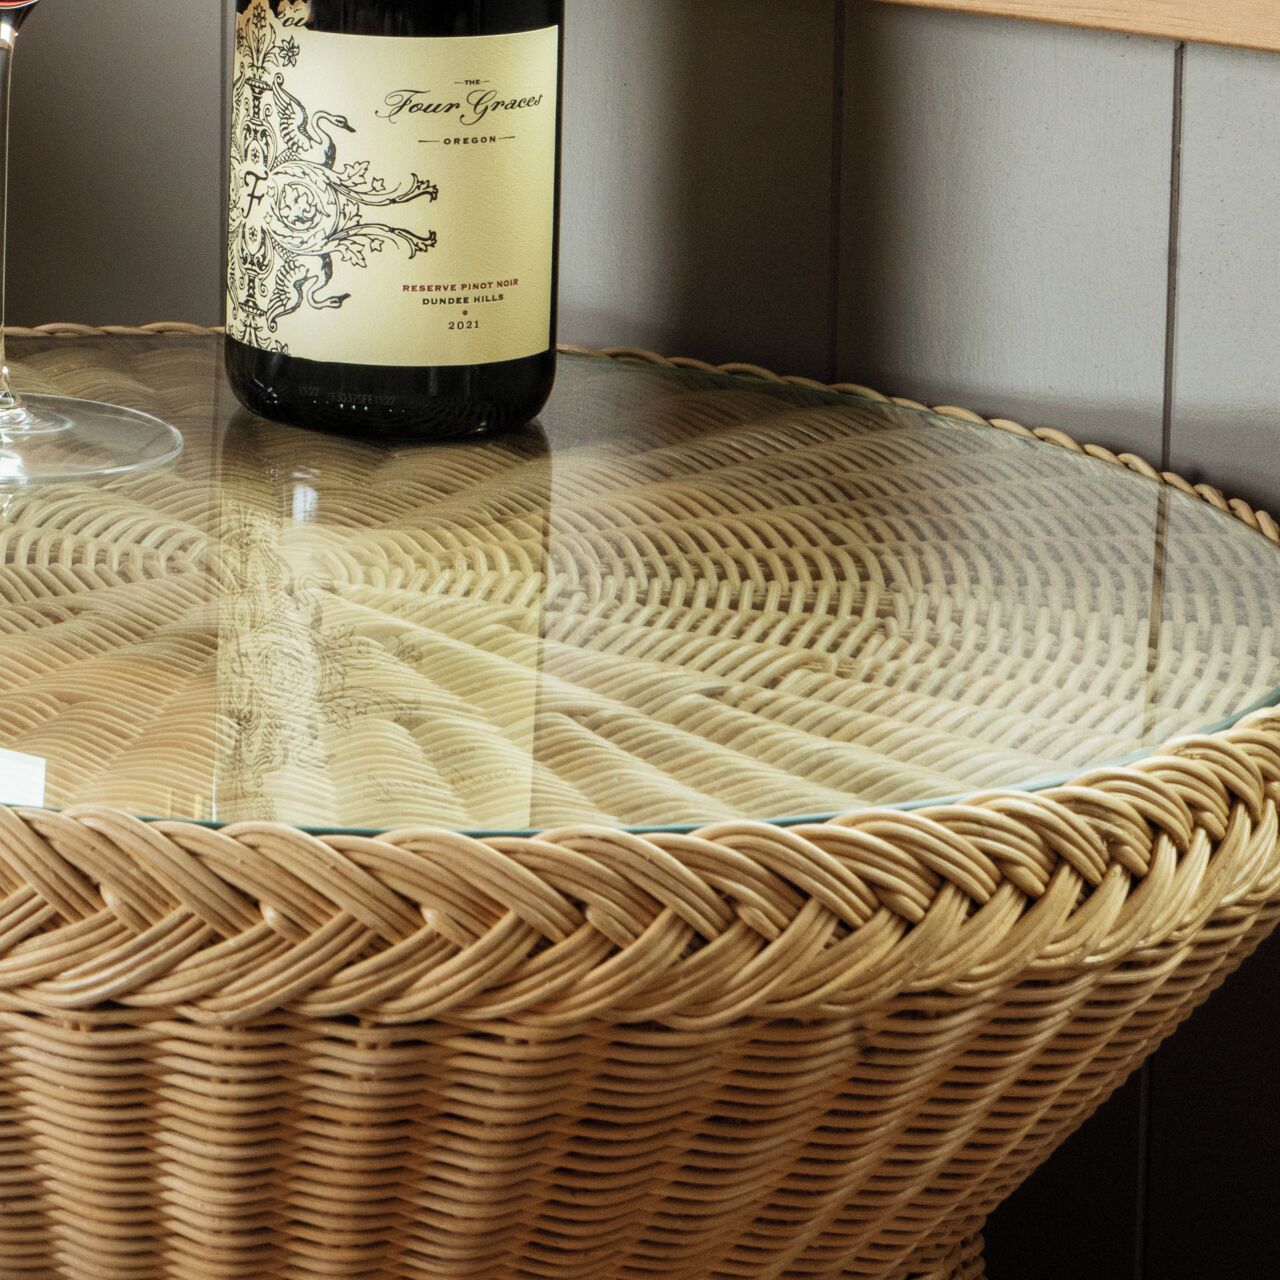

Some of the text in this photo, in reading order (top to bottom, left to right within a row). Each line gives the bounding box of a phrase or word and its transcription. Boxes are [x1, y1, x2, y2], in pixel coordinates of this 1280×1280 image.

[374, 89, 544, 126] Four Graces
[443, 135, 497, 146] OREGON
[402, 279, 519, 292] RESERVE PINOT NOIR
[422, 294, 504, 305] DUNDEE HILLS
[448, 320, 480, 330] 2021
